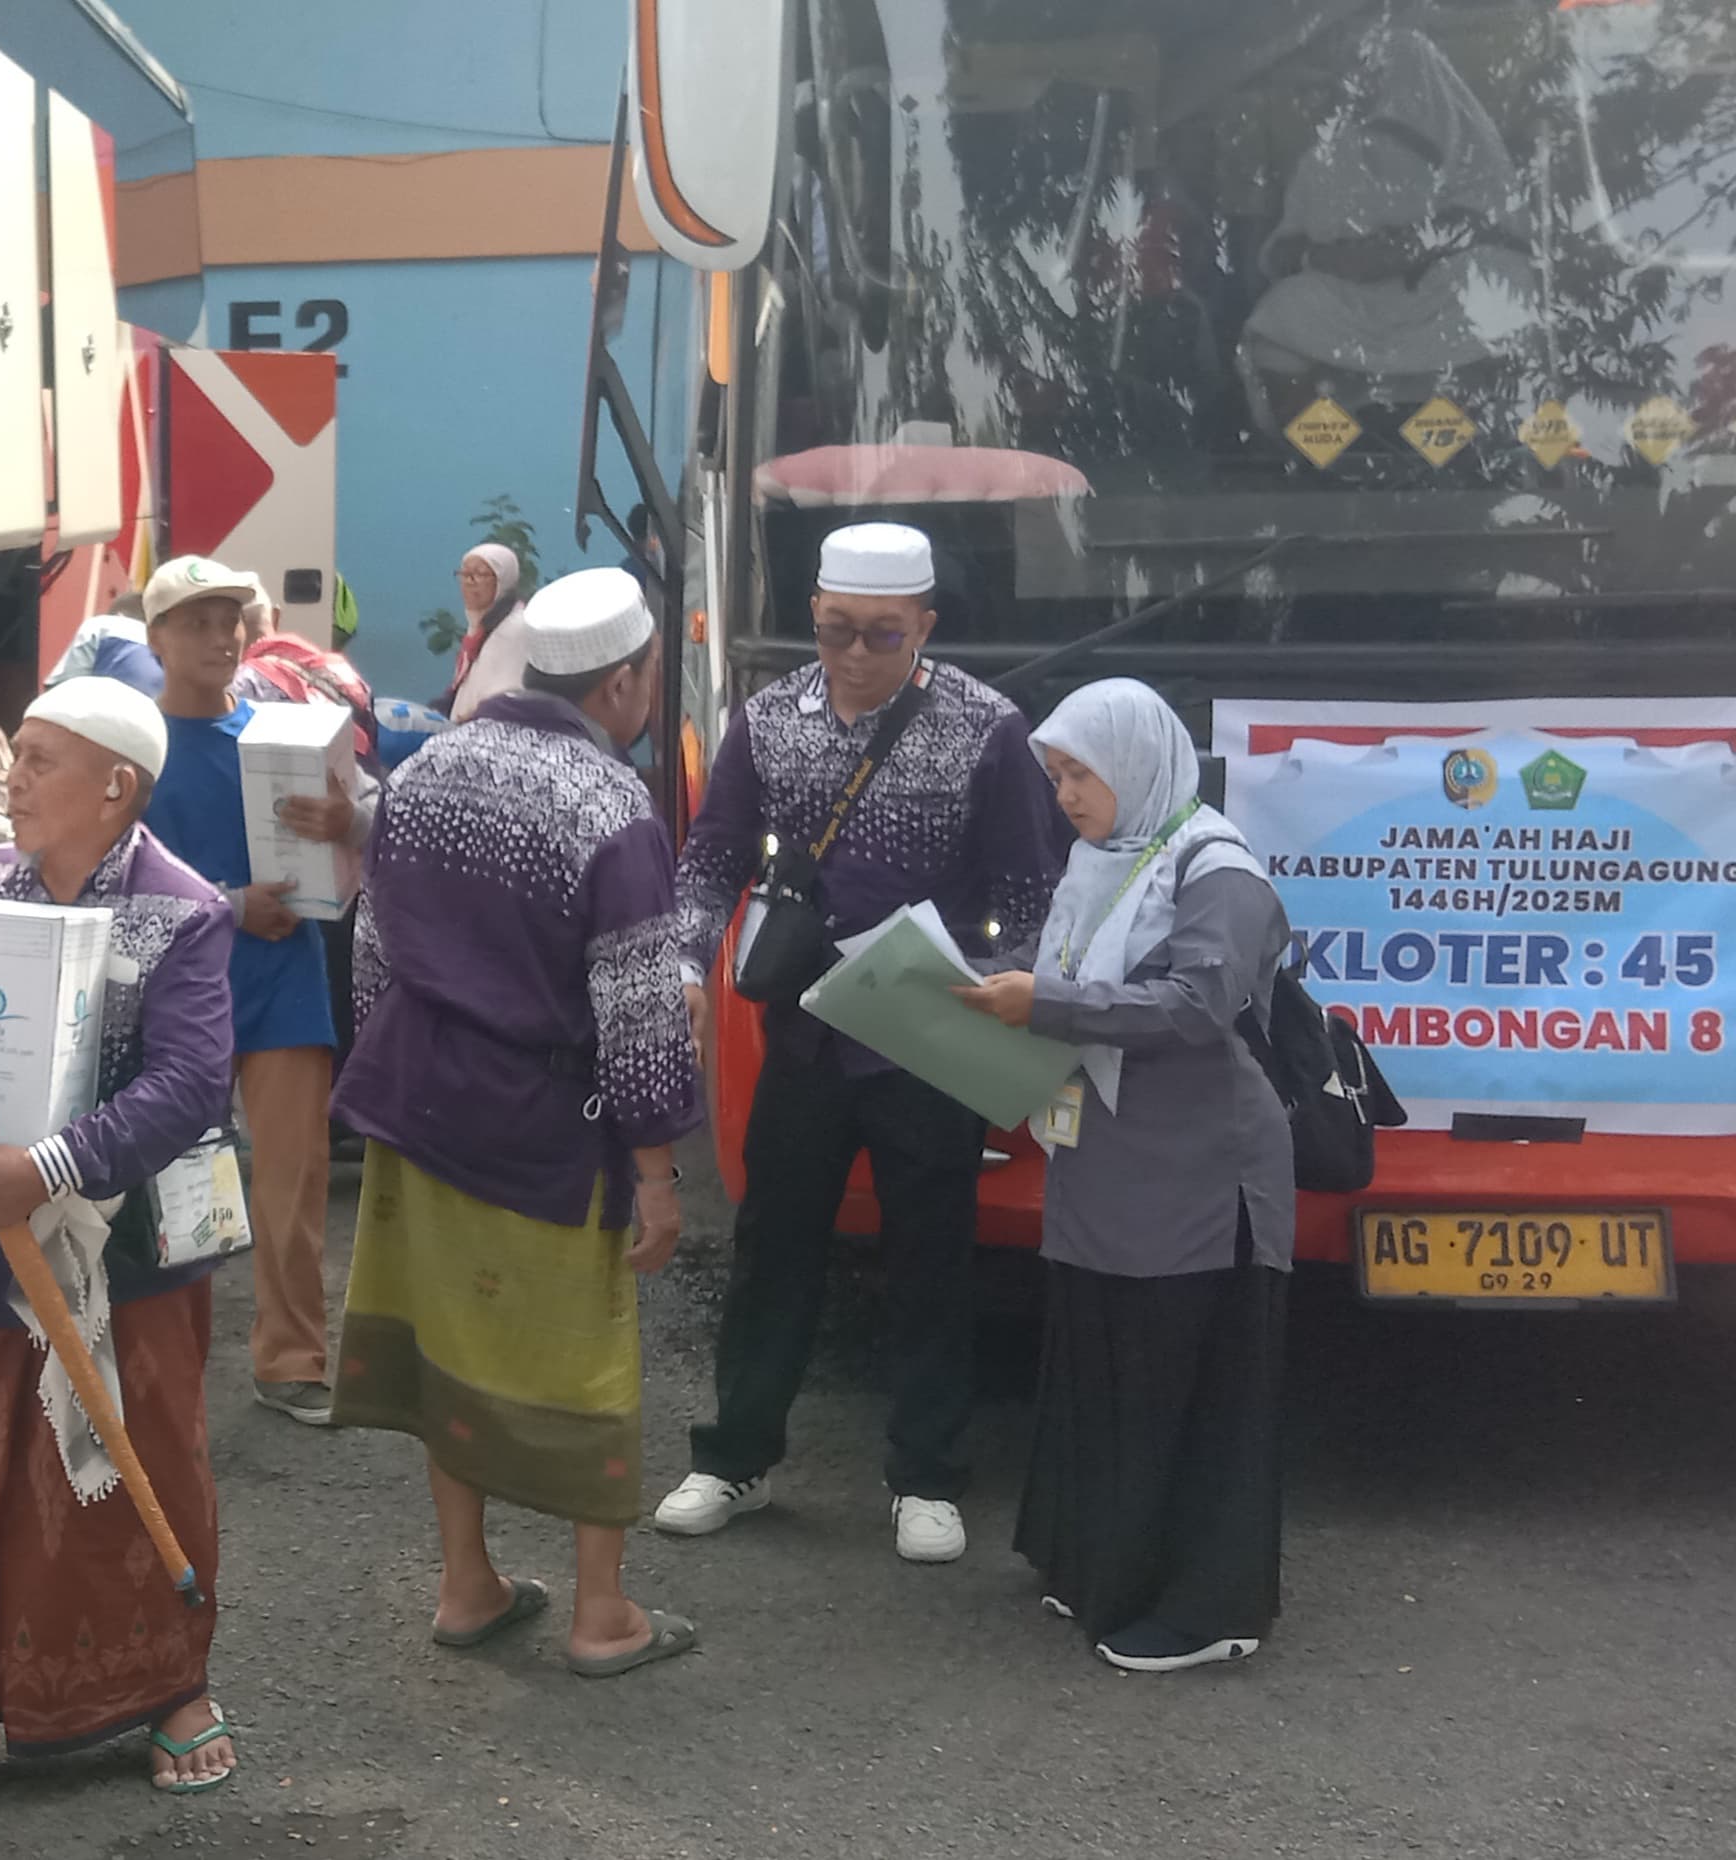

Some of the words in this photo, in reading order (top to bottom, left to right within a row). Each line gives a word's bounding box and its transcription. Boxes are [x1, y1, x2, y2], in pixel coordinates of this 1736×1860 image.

[1379, 825, 1542, 851] JAMA'AH
[1551, 828, 1631, 852] HAJI
[1268, 854, 1476, 881] KABUPATEN
[1486, 859, 1736, 882] TULUNGAGUNG
[1389, 883, 1621, 917] 1446H/2025M
[1291, 930, 1570, 986] KLOTER
[1621, 935, 1716, 987] 45
[1326, 1005, 1668, 1052] MBONGAN
[1689, 1010, 1723, 1052] 8
[1374, 1219, 1430, 1266] AG
[1457, 1220, 1573, 1268] 7109
[1600, 1220, 1655, 1267] UT
[1522, 1272, 1553, 1290] 29
